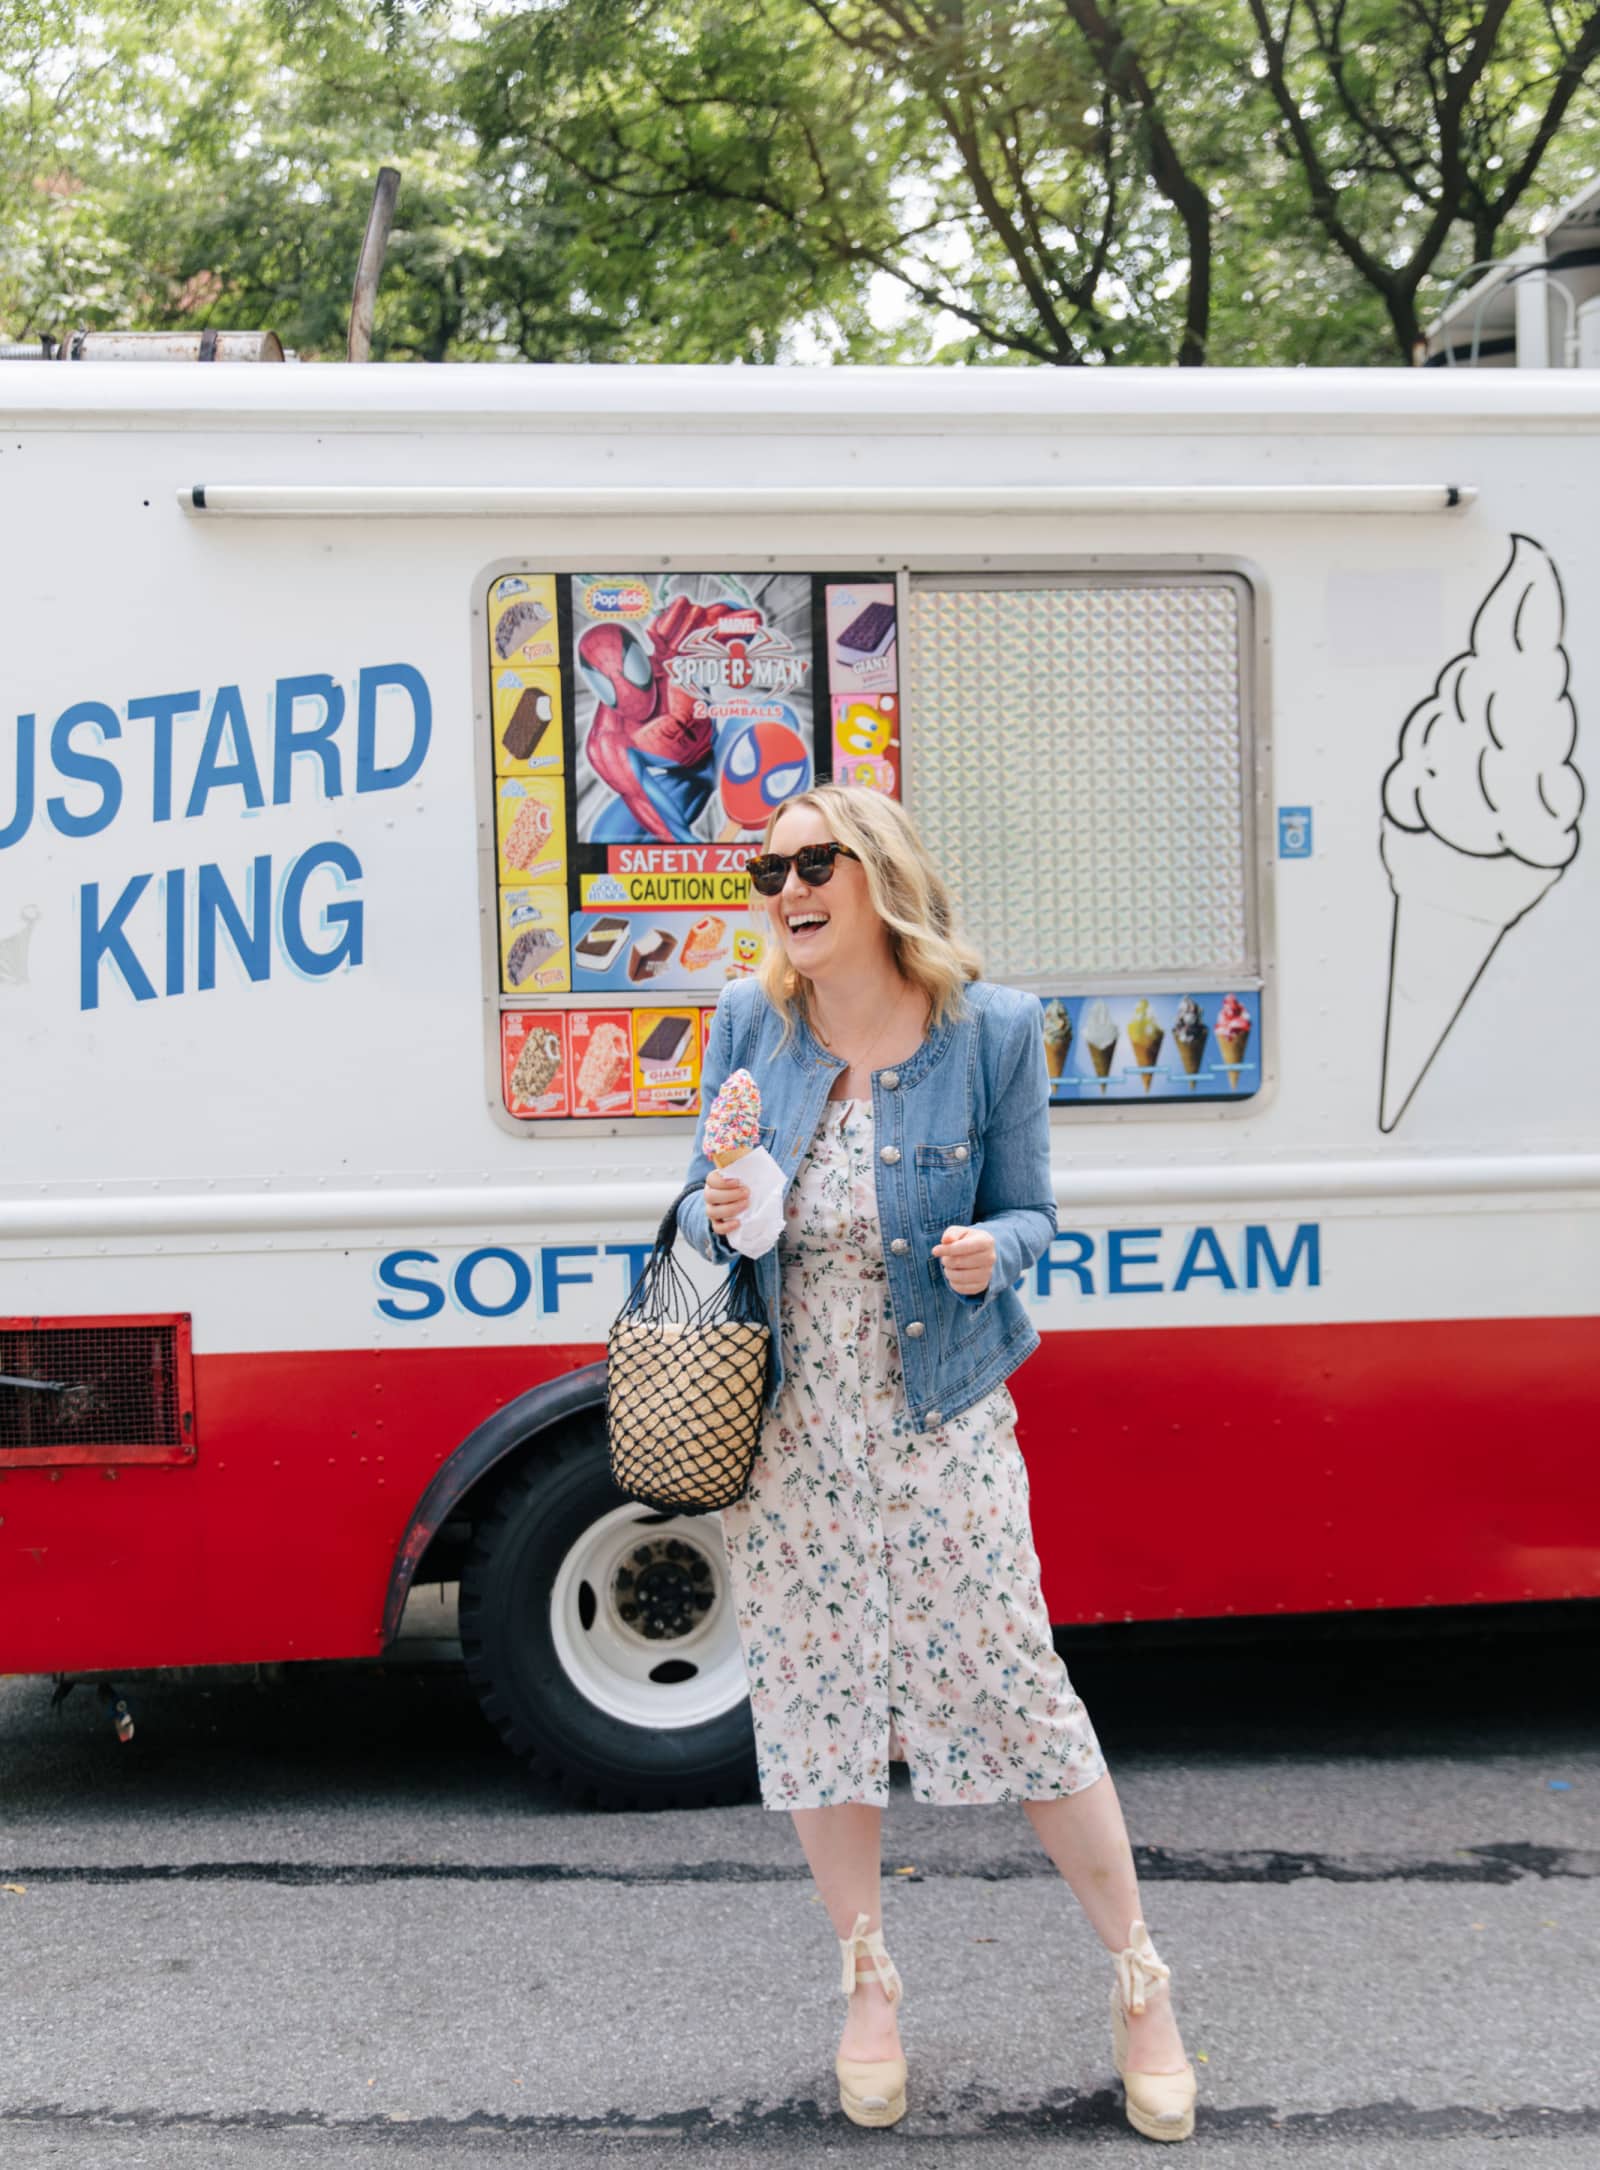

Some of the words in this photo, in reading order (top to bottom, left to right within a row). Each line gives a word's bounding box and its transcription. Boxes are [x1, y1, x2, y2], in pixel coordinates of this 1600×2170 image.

[672, 658, 803, 687] SPIDER-MAN
[693, 701, 708, 718] 2
[709, 704, 784, 718] GUMBALLS
[619, 849, 708, 873] SAFETY
[630, 877, 714, 901] CAUTION
[80, 841, 364, 1011] KING
[649, 1069, 688, 1080] GIANT
[377, 1244, 657, 1320] SOFT
[1013, 1223, 1320, 1296] REAM
